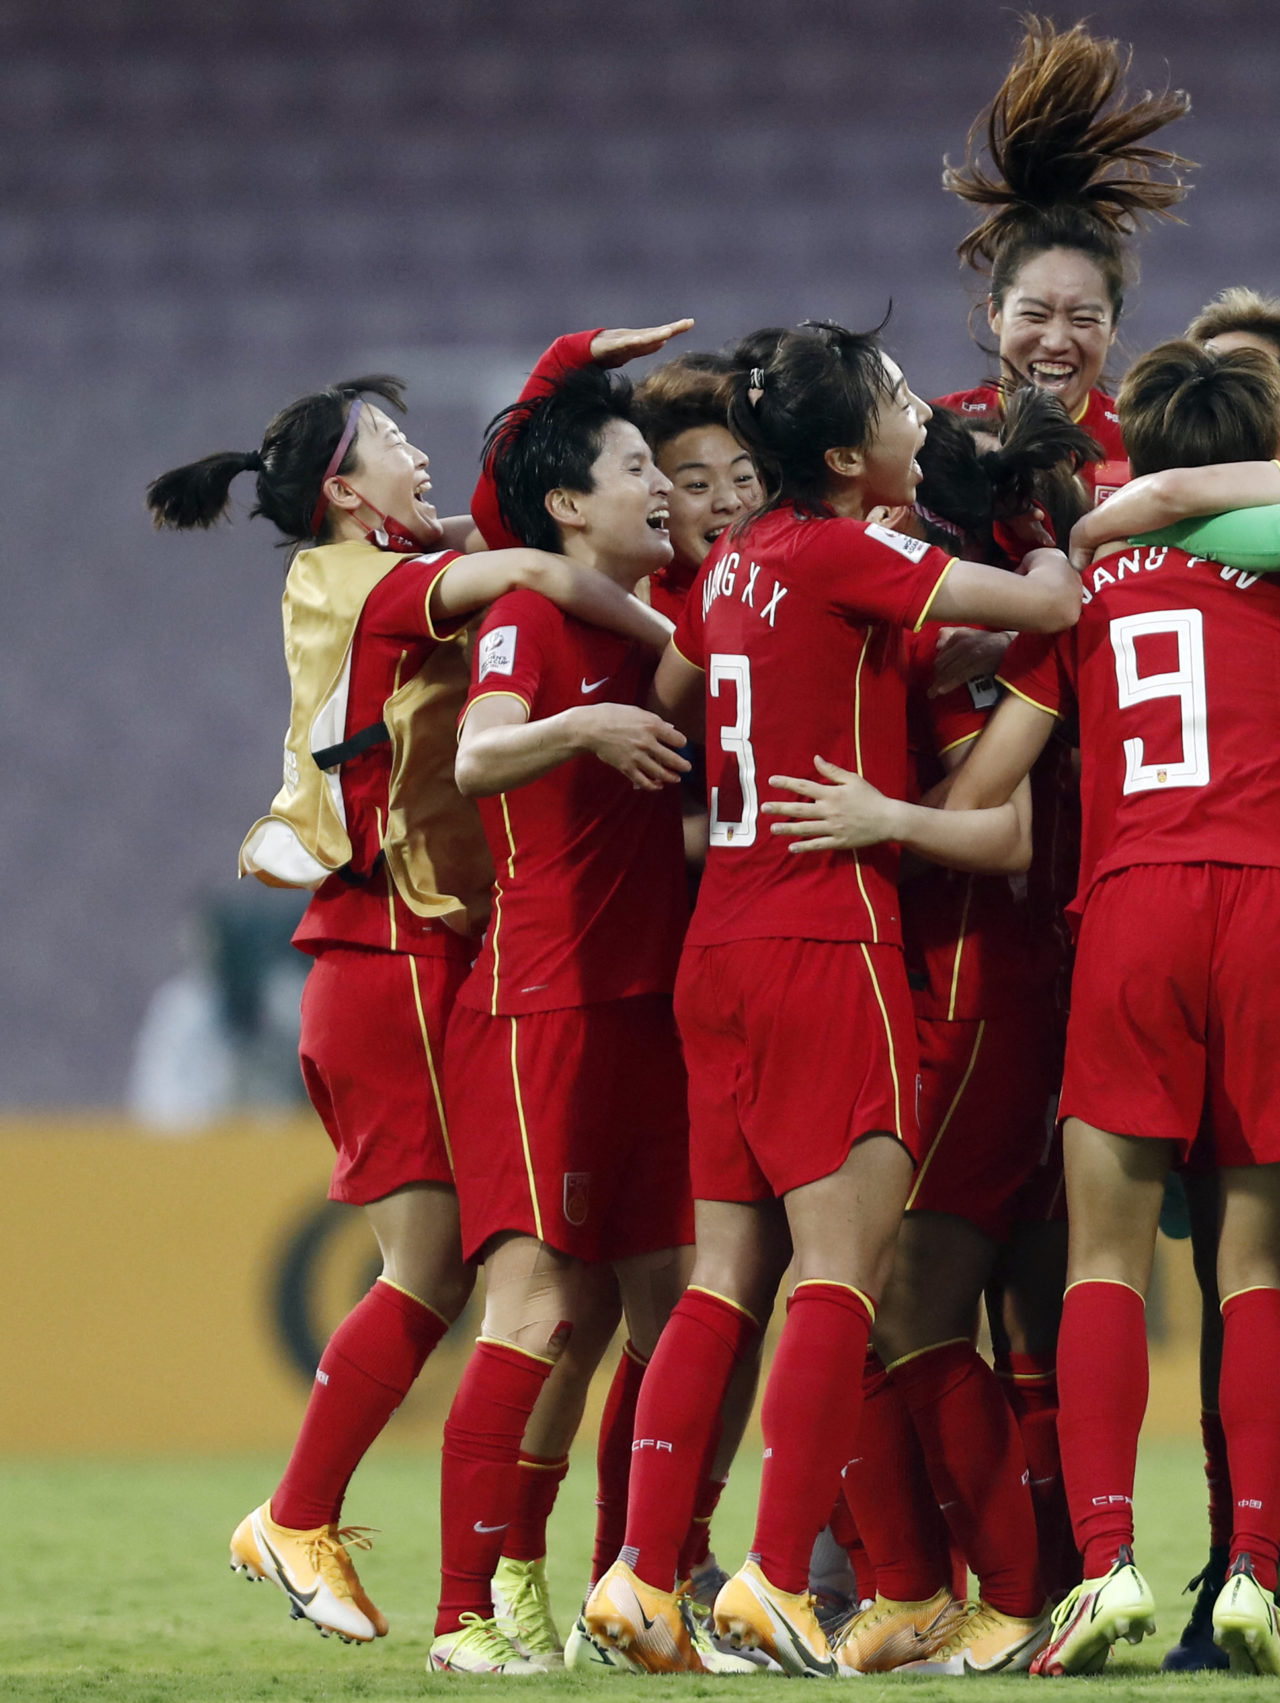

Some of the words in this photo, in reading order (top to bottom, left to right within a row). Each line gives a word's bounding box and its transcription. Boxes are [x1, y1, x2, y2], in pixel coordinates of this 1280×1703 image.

[962, 401, 987, 412] CFA
[741, 561, 761, 609] X
[760, 581, 788, 628] X
[1109, 608, 1211, 797] 9
[709, 653, 759, 848] 3
[631, 1438, 673, 1453] CFA
[1237, 1499, 1263, 1510] 中国
